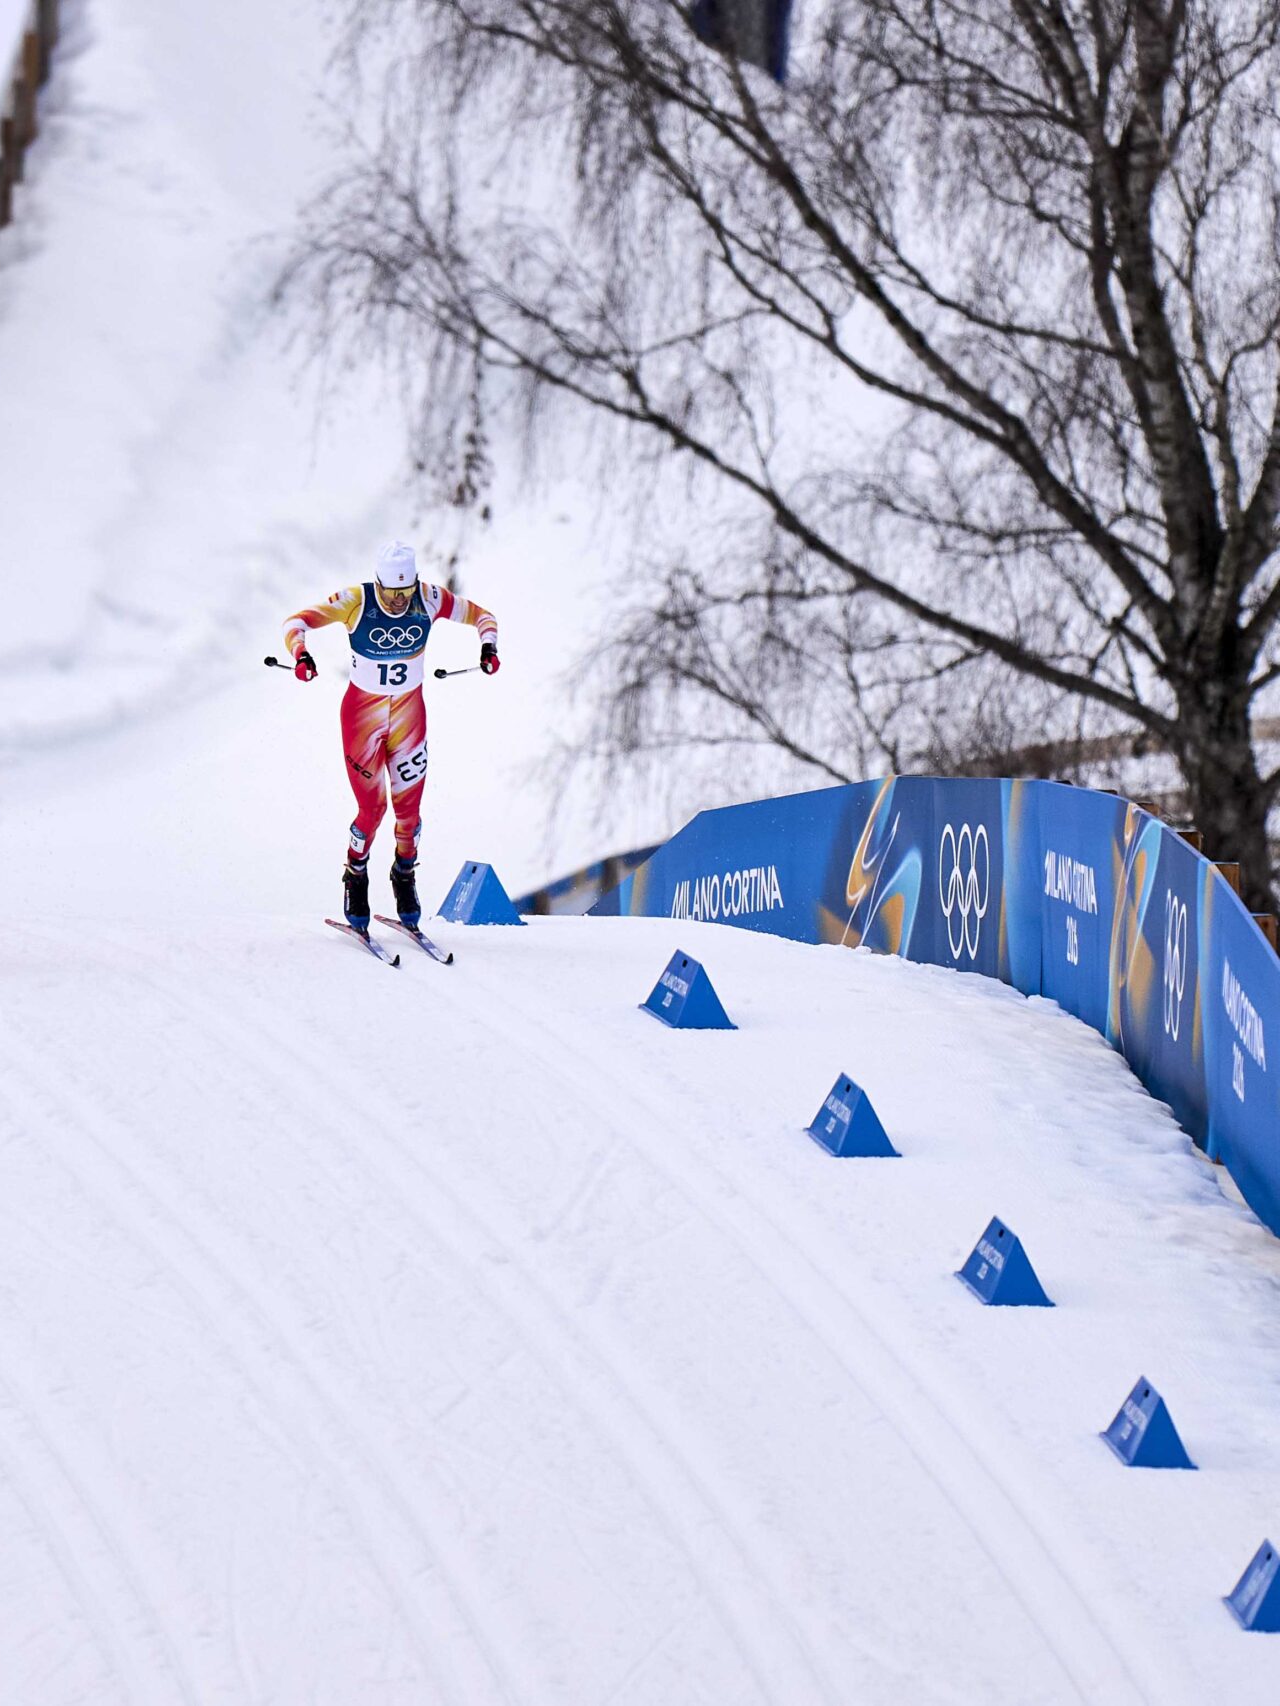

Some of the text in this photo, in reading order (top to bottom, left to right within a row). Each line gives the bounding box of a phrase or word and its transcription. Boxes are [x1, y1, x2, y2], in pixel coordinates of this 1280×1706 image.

[377, 663, 408, 685] 13
[671, 865, 784, 921] MILANO CORTINA
